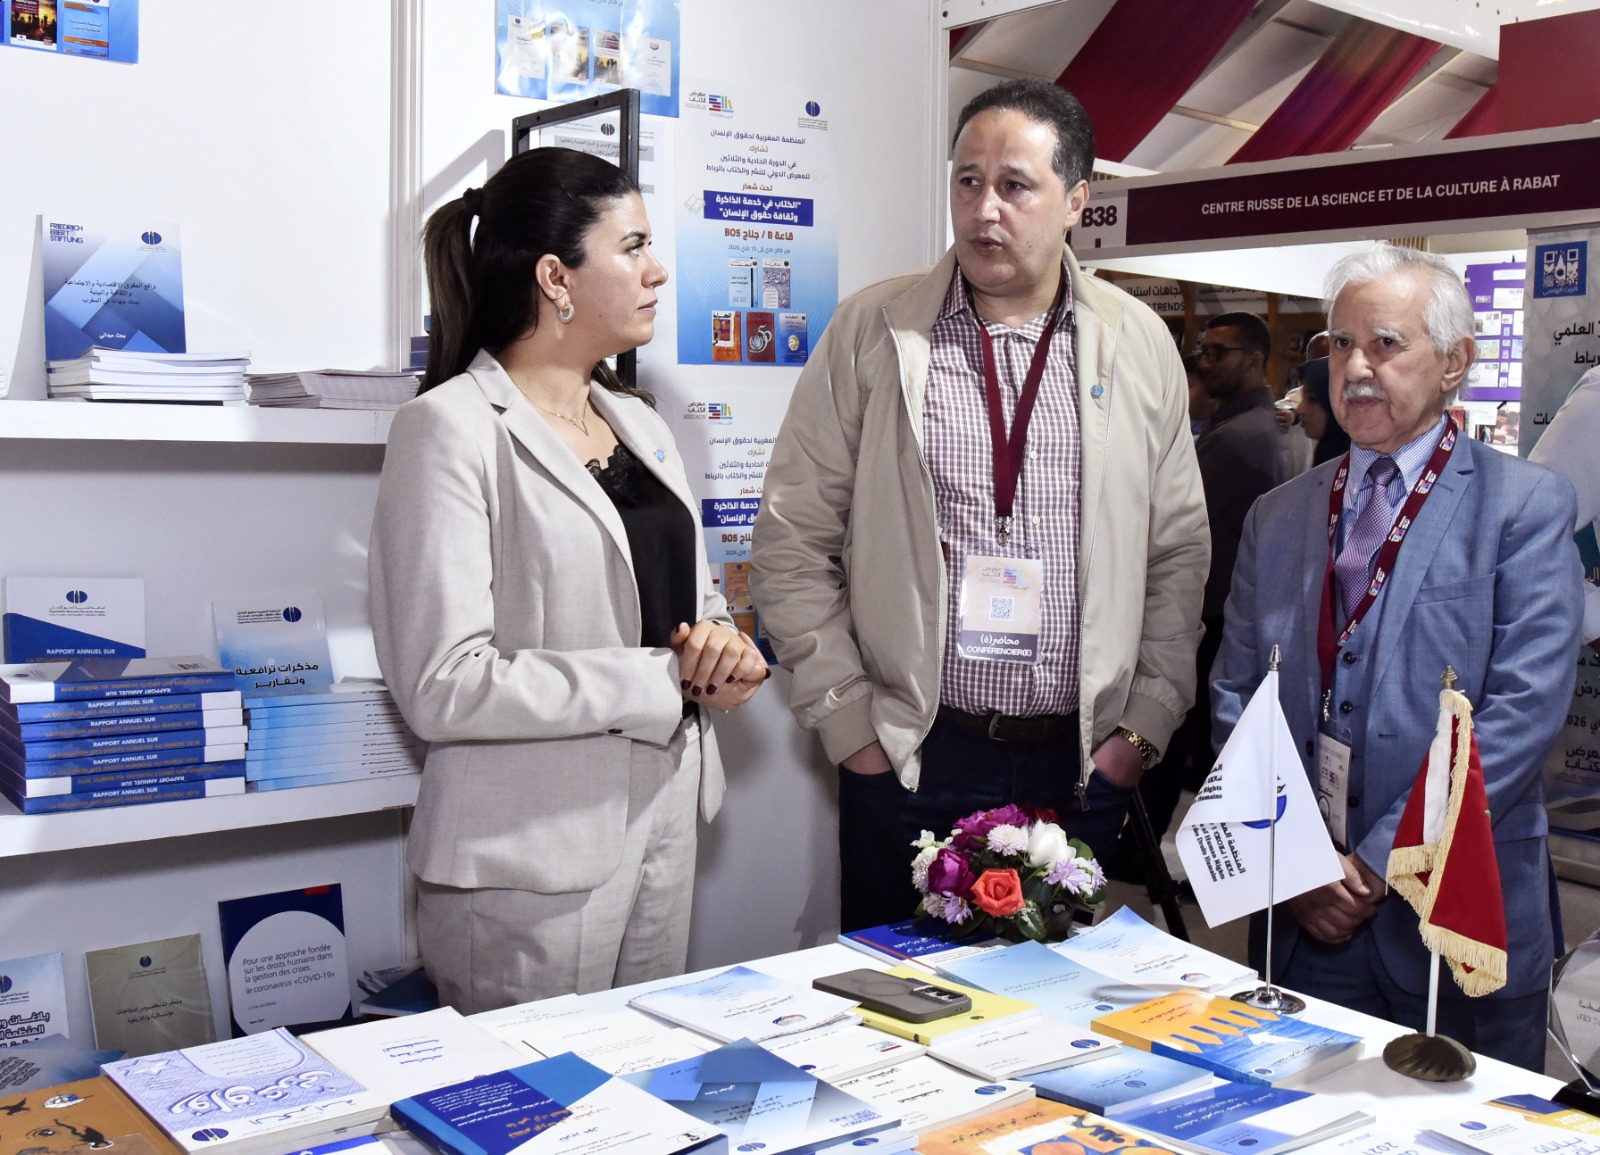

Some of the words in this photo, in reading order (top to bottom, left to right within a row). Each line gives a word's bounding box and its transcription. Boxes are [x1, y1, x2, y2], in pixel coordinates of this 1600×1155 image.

[710, 130, 732, 138] الإنسان
[734, 132, 754, 140] لحقوق
[756, 134, 780, 142] المغربية
[720, 155, 745, 164] والثلاثين
[747, 157, 767, 165] الحادية
[769, 159, 786, 167] الدورة
[707, 164, 726, 173] بالرباط
[788, 161, 796, 170] في
[727, 166, 749, 175] والكتاب
[751, 168, 765, 176] للنشر
[767, 170, 785, 179] الدولي
[787, 172, 810, 180] للمعرض
[742, 183, 758, 191] شعار
[716, 194, 741, 204] الذاكرة
[1201, 201, 1245, 215] CENTRE
[1247, 198, 1284, 211] RUSSE
[1286, 197, 1302, 209] DE
[1304, 195, 1319, 207] LA
[1321, 190, 1376, 206] SCIENCE
[1378, 189, 1394, 201] ET
[1396, 187, 1413, 200] DE
[1417, 185, 1433, 199] LA
[1435, 180, 1497, 197] CULTURE
[1500, 176, 1510, 192] À
[1513, 174, 1561, 190] RABAT
[743, 198, 761, 206] خدمة
[763, 199, 773, 210] في
[751, 211, 772, 220] حقوق
[774, 212, 798, 222] وثقافة
[1081, 205, 1117, 227] B38
[50, 223, 83, 232] FRIEDRICH
[50, 235, 83, 243] STIFTUNG
[743, 230, 760, 240] جناح
[768, 231, 772, 239] B
[775, 231, 793, 241] قاعة
[1153, 303, 1185, 311] TRENDS
[1554, 322, 1594, 345] العلمي
[709, 437, 731, 445] الإنسان
[733, 438, 753, 446] لحقوق
[719, 462, 744, 470] والثلاثين
[704, 471, 724, 480] بالرباط
[725, 472, 747, 480] والكتاب
[714, 502, 738, 512] الذاكرة
[236, 664, 275, 676] ترافعية
[278, 662, 318, 673] مذكرات
[254, 676, 305, 689] وتقارير
[1197, 838, 1207, 855] Droits
[1204, 856, 1217, 882] Humains
[1205, 834, 1216, 858] Human
[1214, 859, 1225, 879] Rights
[243, 958, 258, 966] Pour
[275, 947, 306, 961] approche
[308, 944, 331, 954] fondée
[256, 965, 265, 973] les
[267, 961, 286, 971] droits
[287, 956, 315, 966] humains
[317, 953, 333, 961] dans
[245, 975, 250, 983] la
[253, 971, 277, 982] gestion
[279, 969, 290, 977] des
[246, 986, 252, 994] le
[254, 981, 292, 992] coronavirus
[294, 972, 336, 985] «COVID-19»
[5, 1024, 45, 1040] المنظمة
